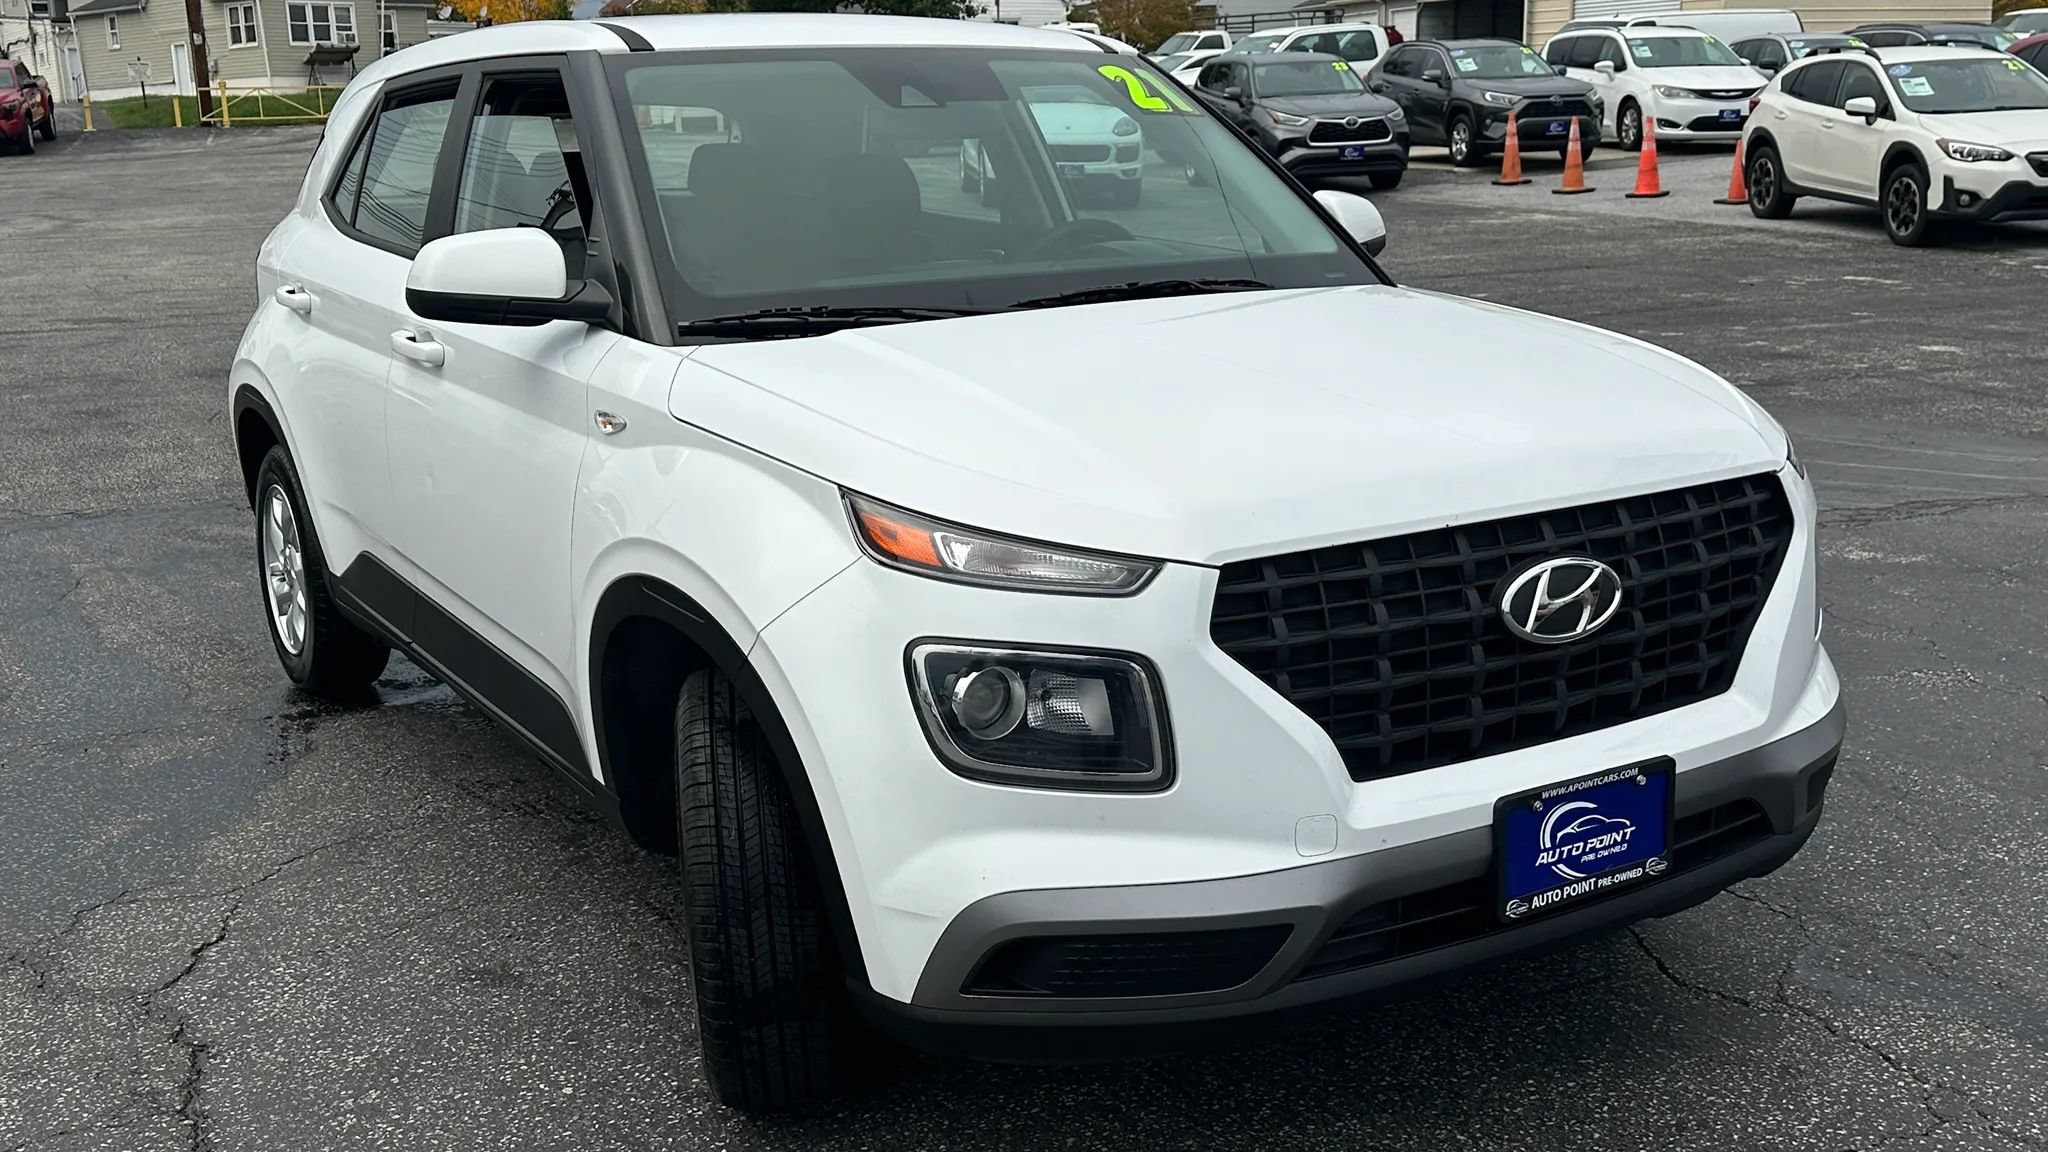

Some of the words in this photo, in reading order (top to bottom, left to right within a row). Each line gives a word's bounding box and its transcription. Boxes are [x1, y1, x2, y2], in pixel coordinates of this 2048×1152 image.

[1541, 767, 1639, 800] WWW.APOINTCARS.COM
[1535, 841, 1584, 867] AUTO
[1585, 826, 1636, 853] POINT
[1597, 843, 1628, 859] OWNED
[1531, 889, 1562, 909] AUTO
[1563, 878, 1596, 899] POINT
[1597, 867, 1643, 889] PRE-OWNED
